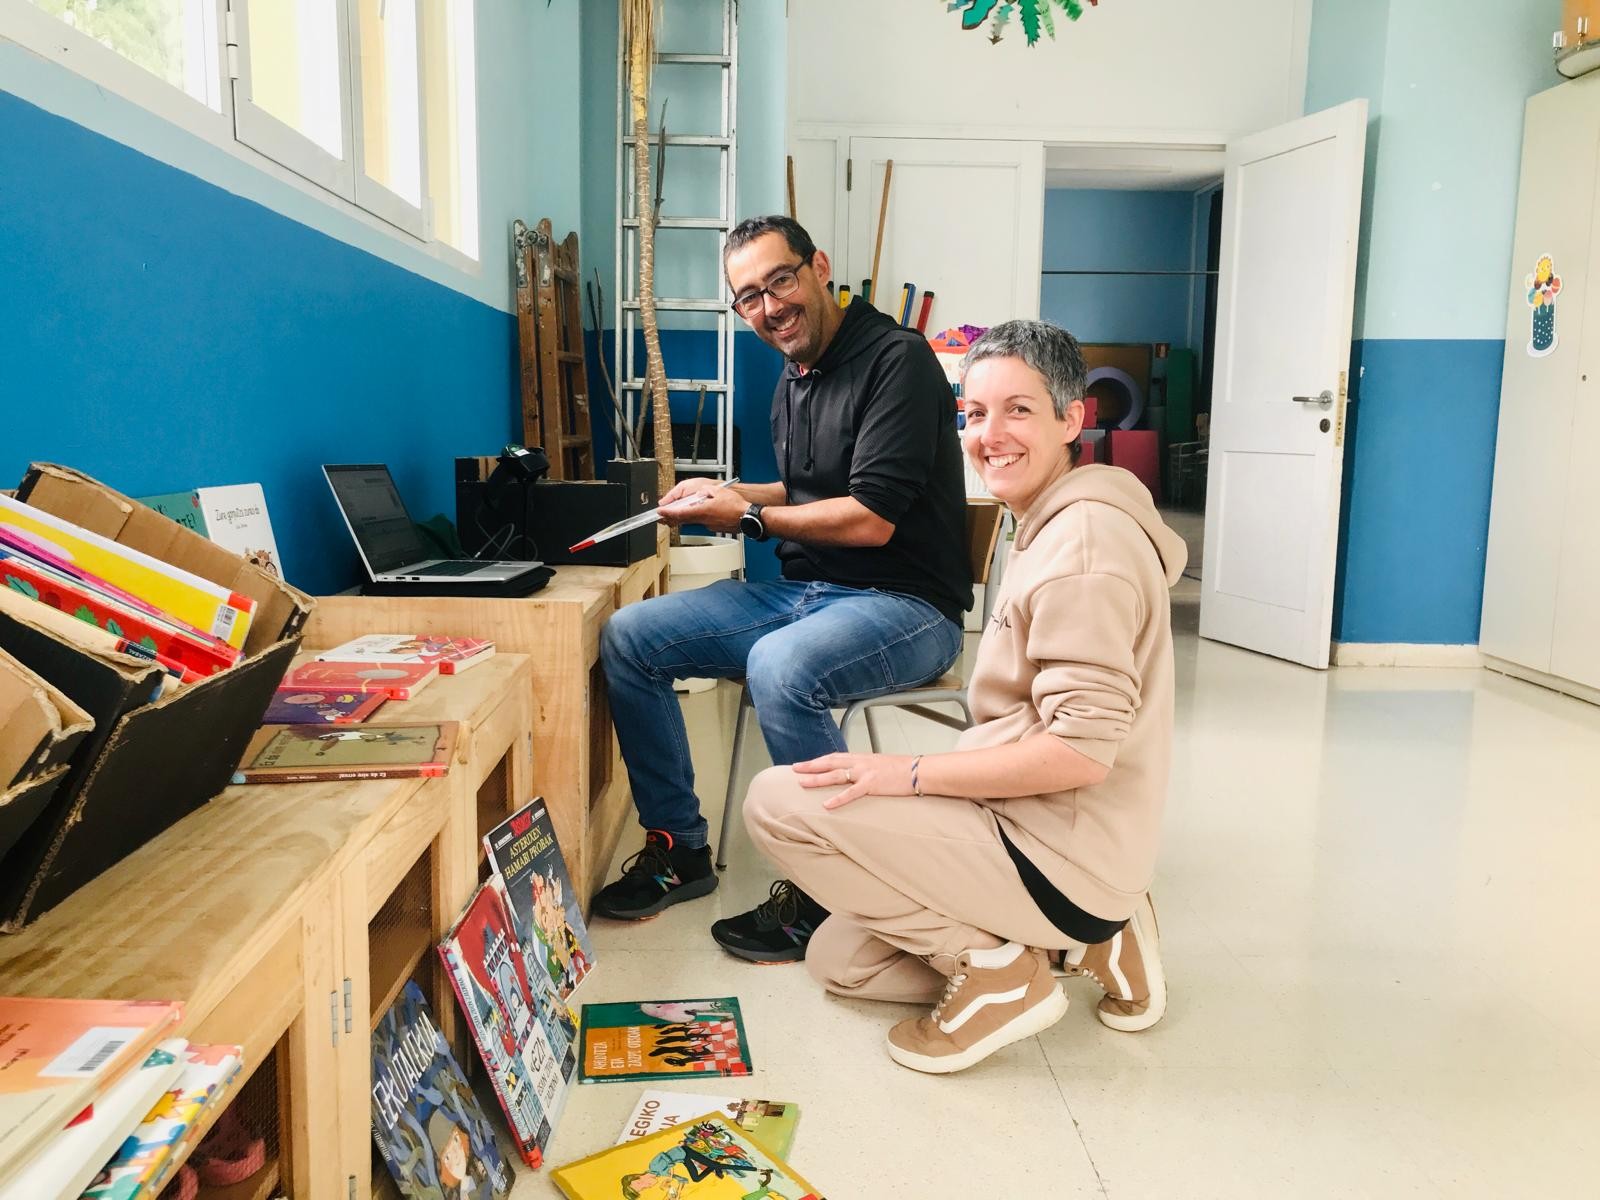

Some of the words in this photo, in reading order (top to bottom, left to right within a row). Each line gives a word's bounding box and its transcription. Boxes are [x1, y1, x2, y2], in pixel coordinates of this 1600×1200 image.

[504, 851, 531, 880] HAMABI
[529, 832, 554, 860] PROBAK
[510, 825, 542, 859] ASTERIXEN
[373, 1011, 441, 1130] EZKUTALEKUA
[628, 1100, 661, 1139] EGIKO
